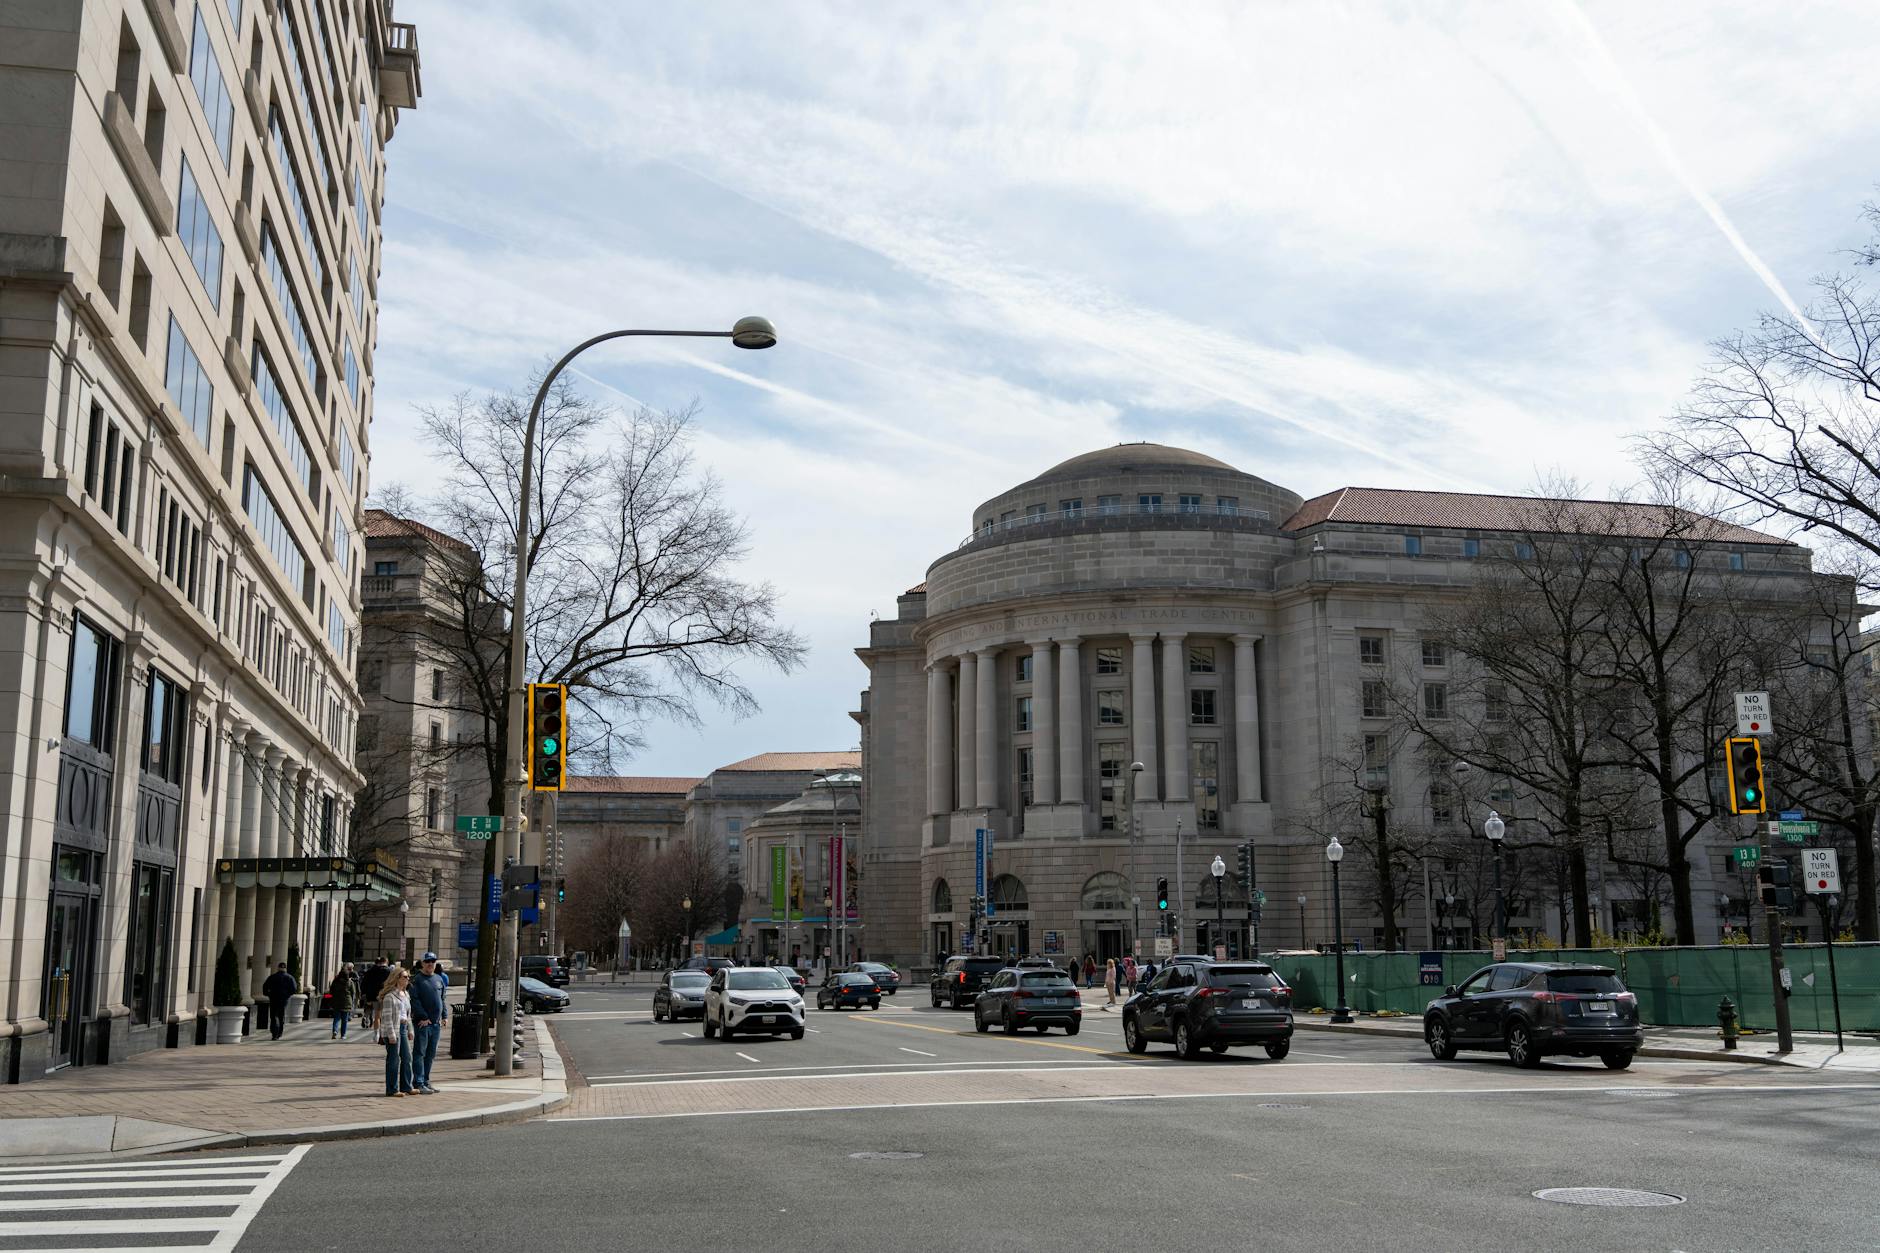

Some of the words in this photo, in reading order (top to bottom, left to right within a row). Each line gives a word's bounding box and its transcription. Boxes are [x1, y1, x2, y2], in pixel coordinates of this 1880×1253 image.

[1012, 611, 1128, 630] INTERNATIONAL
[1140, 609, 1189, 619] TRADE
[1201, 609, 1256, 621] CENTER
[1744, 695, 1759, 703] NO
[472, 818, 477, 829] E
[466, 831, 492, 840] 1200
[1787, 834, 1803, 842] 1300
[1740, 849, 1748, 860] 13
[1811, 852, 1827, 861] NO
[1741, 860, 1756, 868] 400
[1810, 862, 1830, 870] TURN
[1807, 871, 1818, 879] ON
